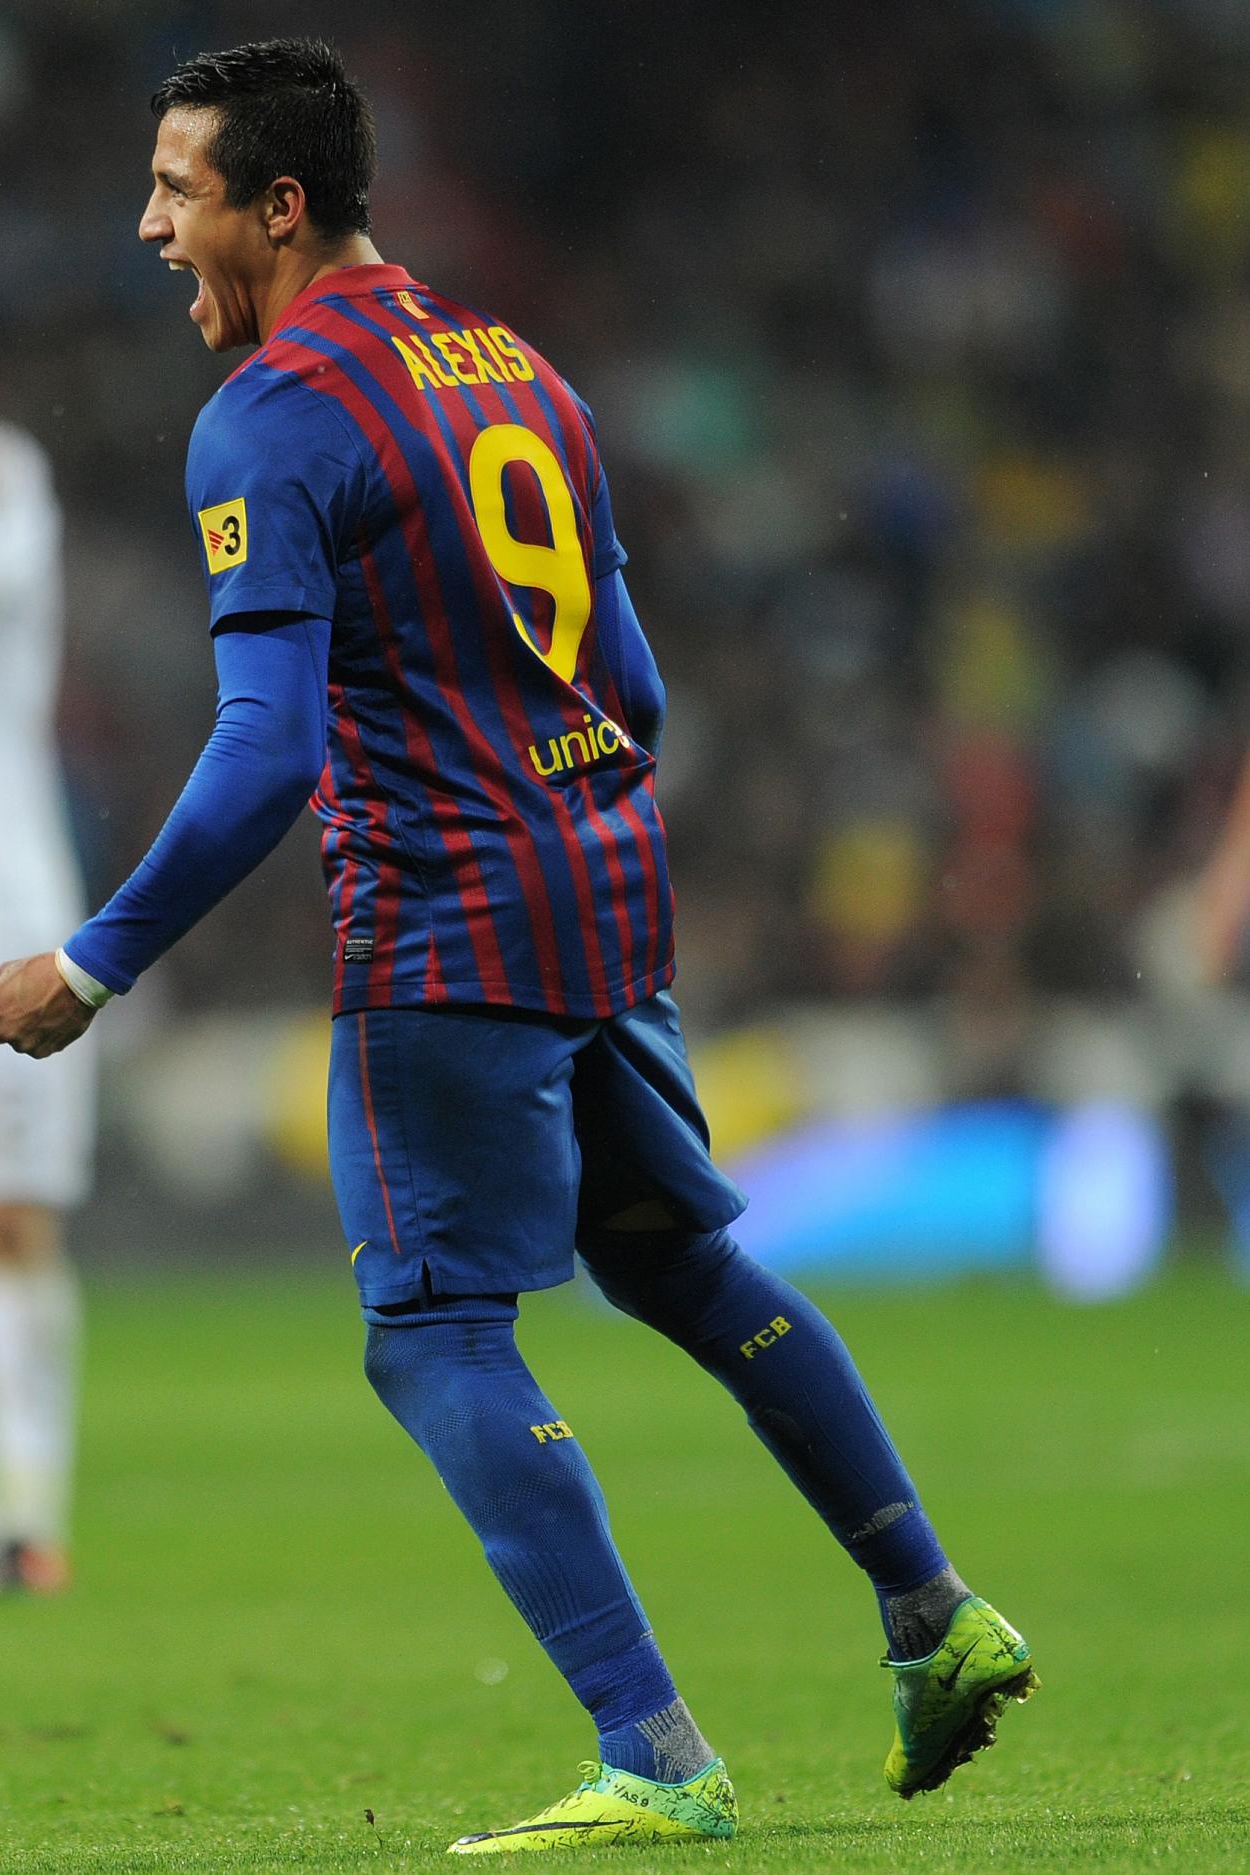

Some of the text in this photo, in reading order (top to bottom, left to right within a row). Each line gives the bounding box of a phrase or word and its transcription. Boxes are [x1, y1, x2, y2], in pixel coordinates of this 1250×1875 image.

[391, 326, 536, 390] ALEXIS
[222, 515, 241, 556] 3
[469, 424, 592, 684] 9
[739, 1315, 792, 1360] FCB
[530, 1420, 574, 1444] FCB
